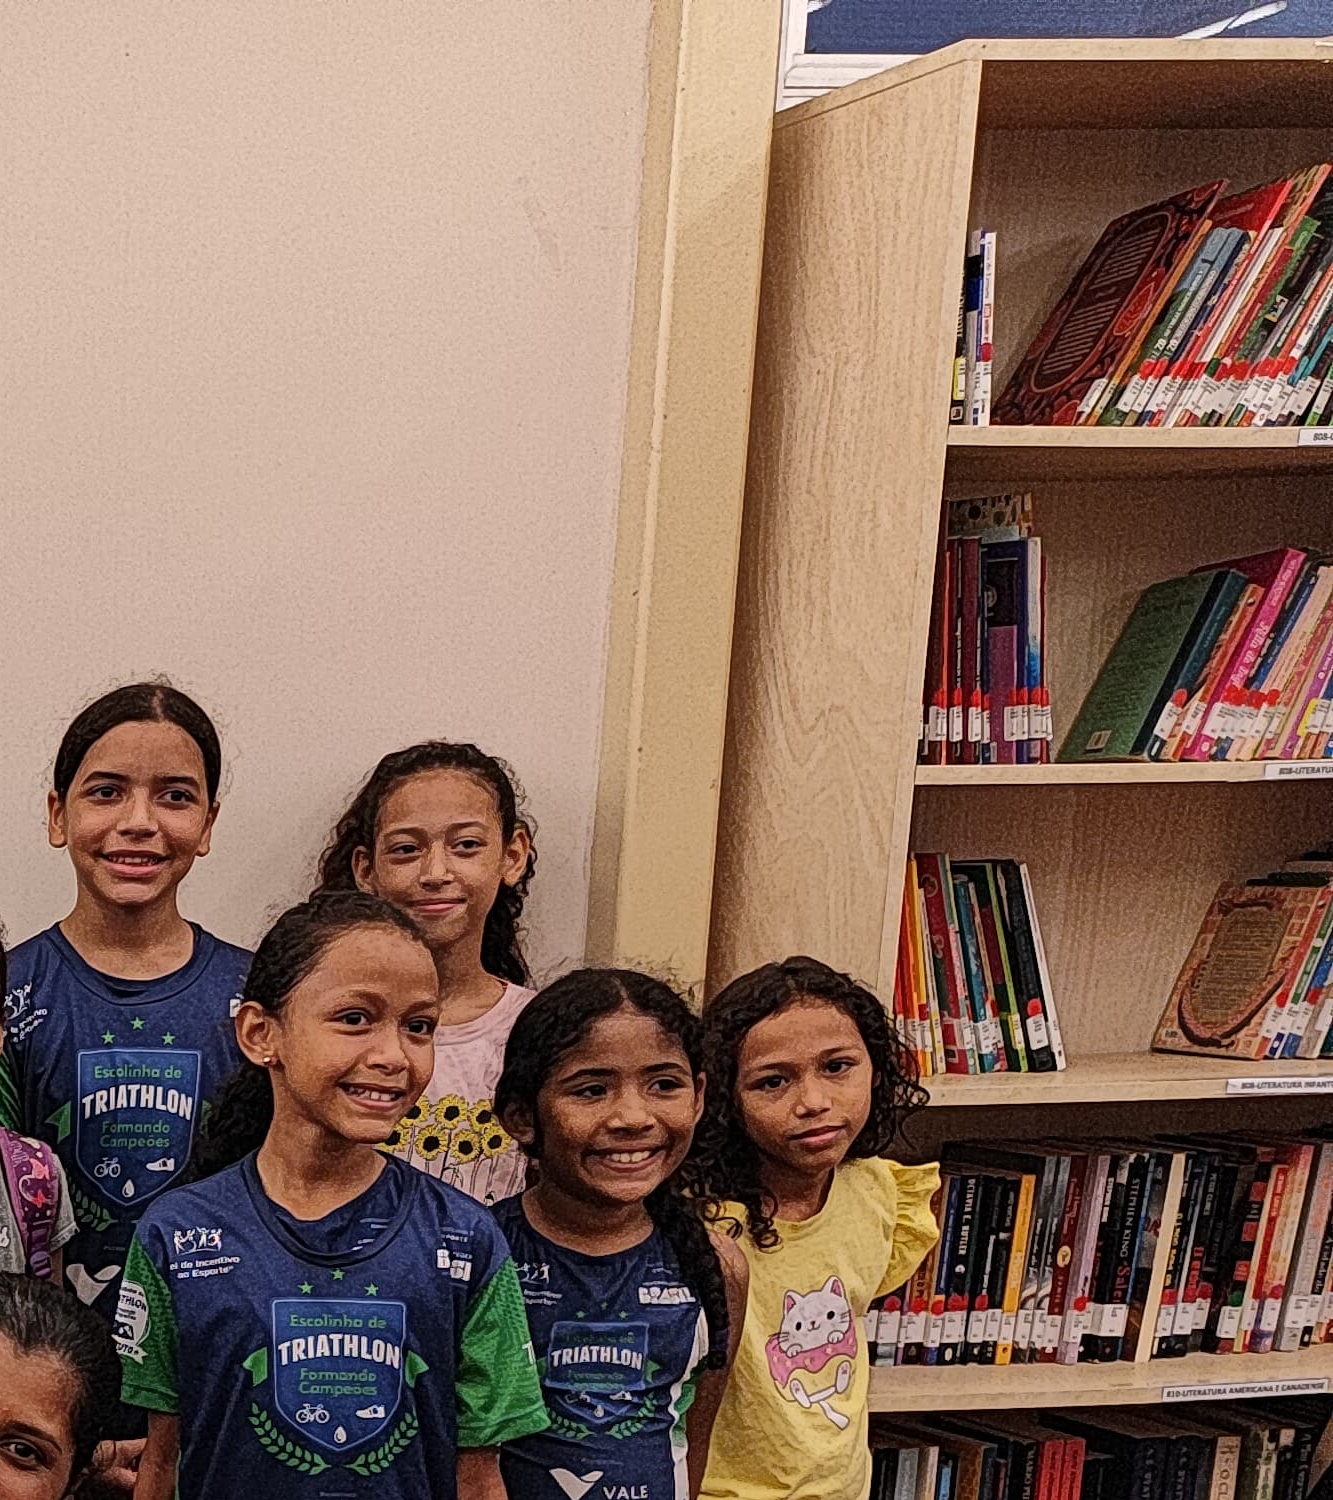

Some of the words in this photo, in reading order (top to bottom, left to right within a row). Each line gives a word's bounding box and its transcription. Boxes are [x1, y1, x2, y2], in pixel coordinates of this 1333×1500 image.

[94, 1064, 160, 1079] Escolinha
[164, 1065, 182, 1079] de
[82, 1084, 193, 1121] TRIATHLON
[102, 1120, 170, 1133] Formando
[100, 1134, 170, 1149] Campeões
[963, 1178, 977, 1212] OCTAVIA
[1124, 1177, 1142, 1227] STEPHEN
[1120, 1229, 1134, 1258] KING
[196, 1256, 241, 1267] Incentivo
[638, 1286, 696, 1305] BRASIL
[290, 1313, 364, 1328] Escolinha
[368, 1315, 388, 1329] de
[278, 1333, 401, 1370] TRIATHLON
[551, 1345, 644, 1370] TRIATHLON
[300, 1367, 377, 1382] Formando
[1229, 1385, 1273, 1394] AMERICANA
[1023, 1447, 1037, 1485] MARIO
[603, 1484, 649, 1500] VALE
